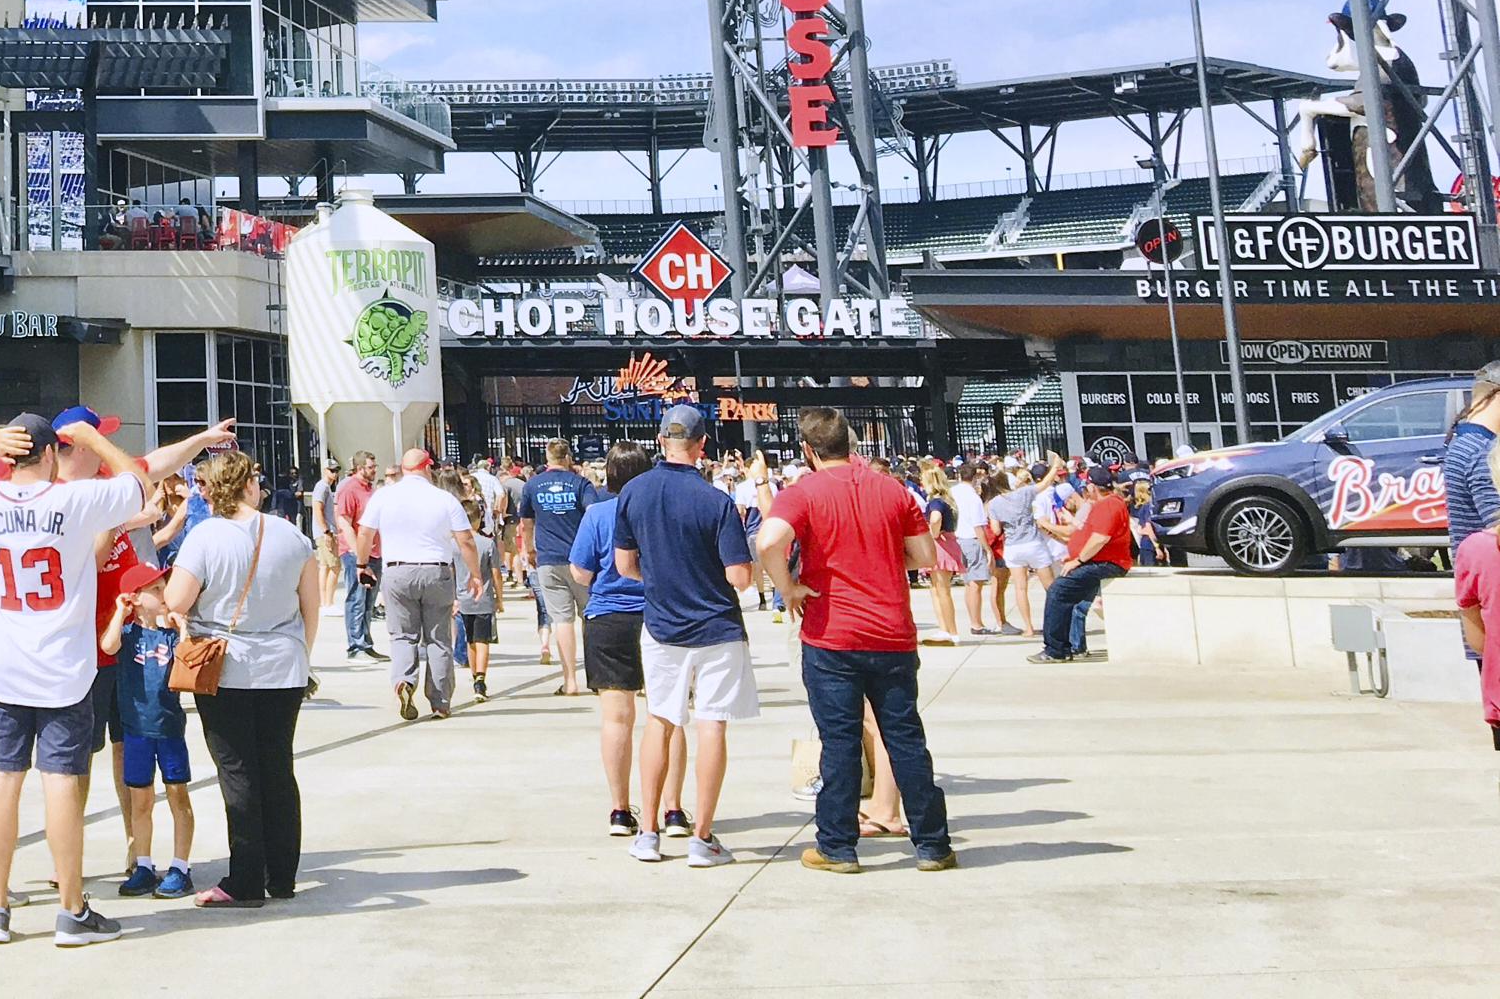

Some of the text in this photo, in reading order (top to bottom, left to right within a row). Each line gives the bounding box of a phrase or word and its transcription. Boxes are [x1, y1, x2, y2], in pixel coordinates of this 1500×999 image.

[1144, 230, 1177, 252] OPN
[1331, 226, 1470, 260] BURGER
[326, 248, 430, 297] TERRAPIN
[658, 253, 713, 291] CH
[1263, 279, 1331, 298] TIME
[1345, 279, 1395, 298] ALL
[1407, 279, 1459, 298] THE
[11, 310, 59, 338] BAR
[448, 297, 911, 336] CHOP HOUSE GATE
[1269, 344, 1305, 359] OPEN
[1311, 344, 1373, 359] EVERYDAY
[717, 397, 779, 421] PARK
[1081, 392, 1127, 405] BURGERS
[1146, 392, 1200, 405] COLD BER
[1220, 392, 1235, 404] HO
[1291, 392, 1320, 404] FRIES
[1102, 439, 1128, 459] BURGE
[536, 492, 577, 504] COSTA
[1328, 455, 1446, 530] Bra
[41, 510, 65, 536] JR.
